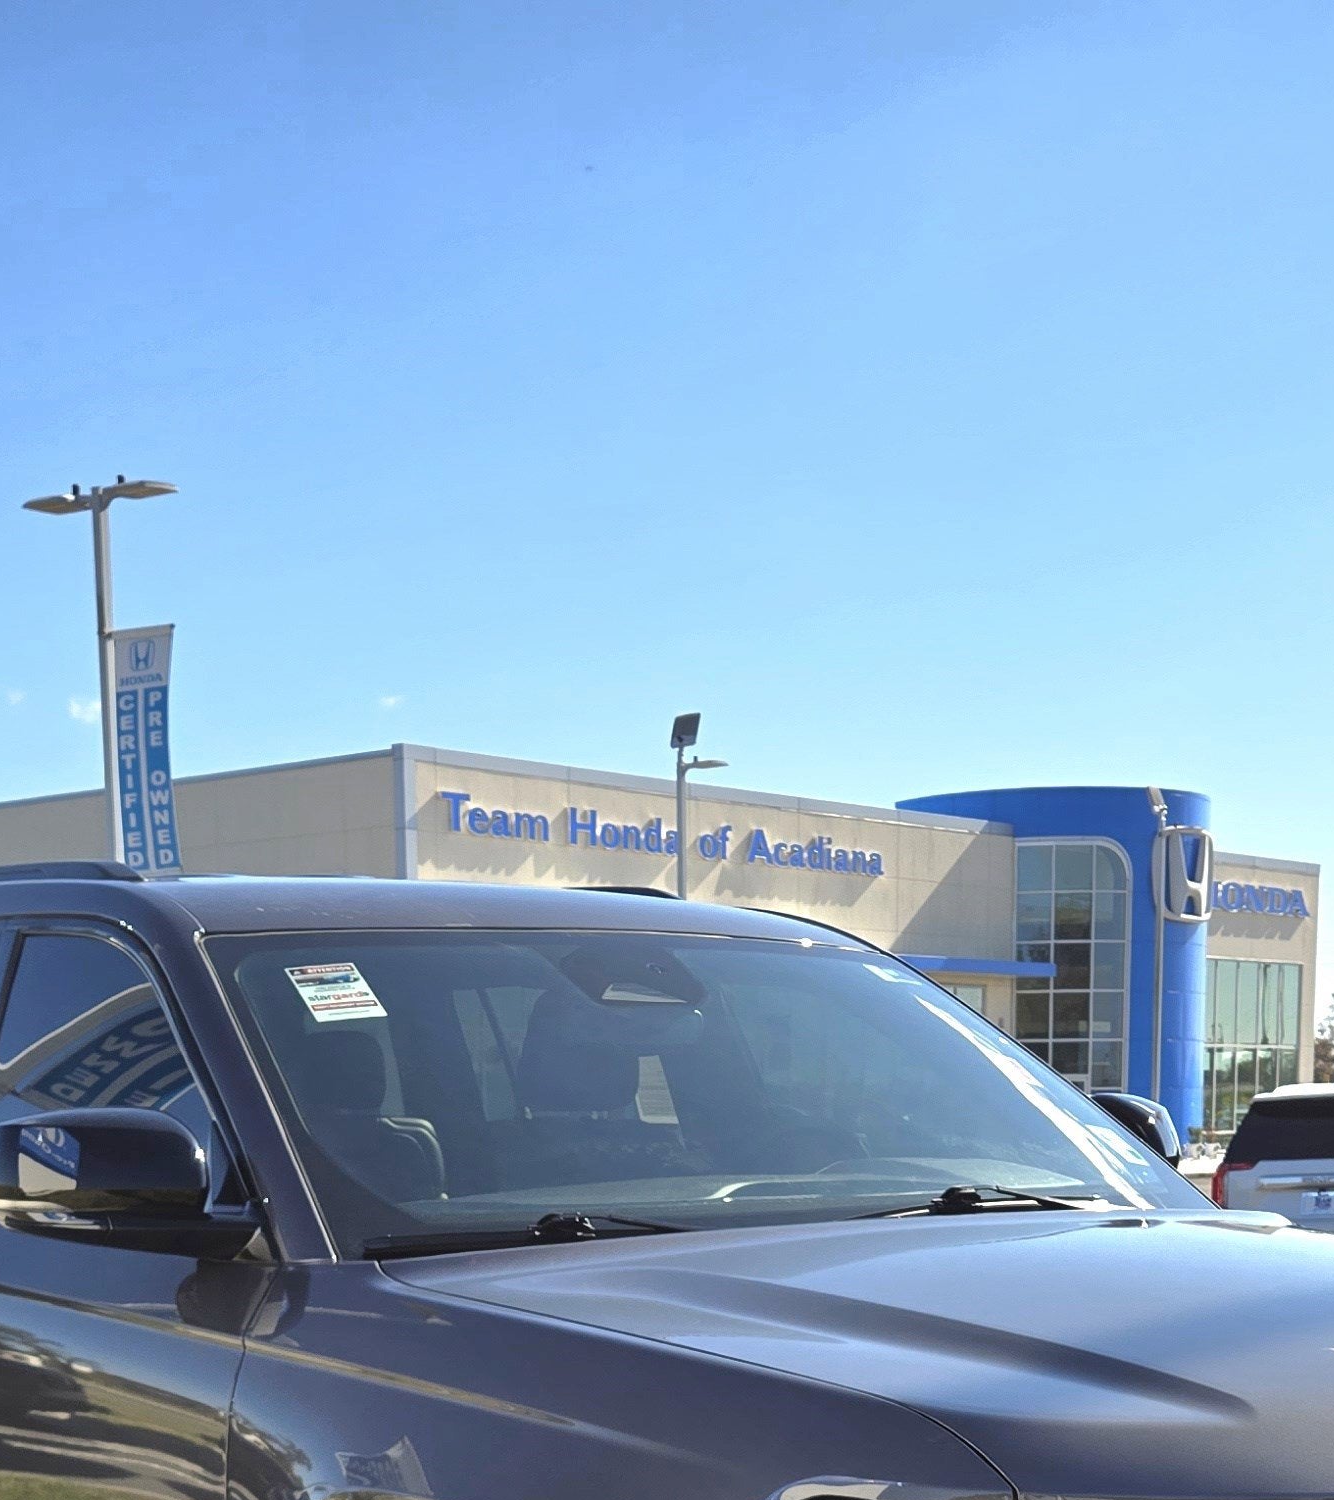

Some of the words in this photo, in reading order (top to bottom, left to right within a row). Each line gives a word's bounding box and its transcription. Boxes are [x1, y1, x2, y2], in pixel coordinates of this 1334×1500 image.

[120, 674, 163, 687] HONDA
[148, 691, 164, 747] PRE
[119, 694, 144, 868] CERTIFIED
[150, 769, 174, 866] OWNED
[441, 791, 550, 842] Team
[568, 807, 678, 856] Honda
[699, 825, 732, 861] of
[748, 828, 884, 876] Acadiana
